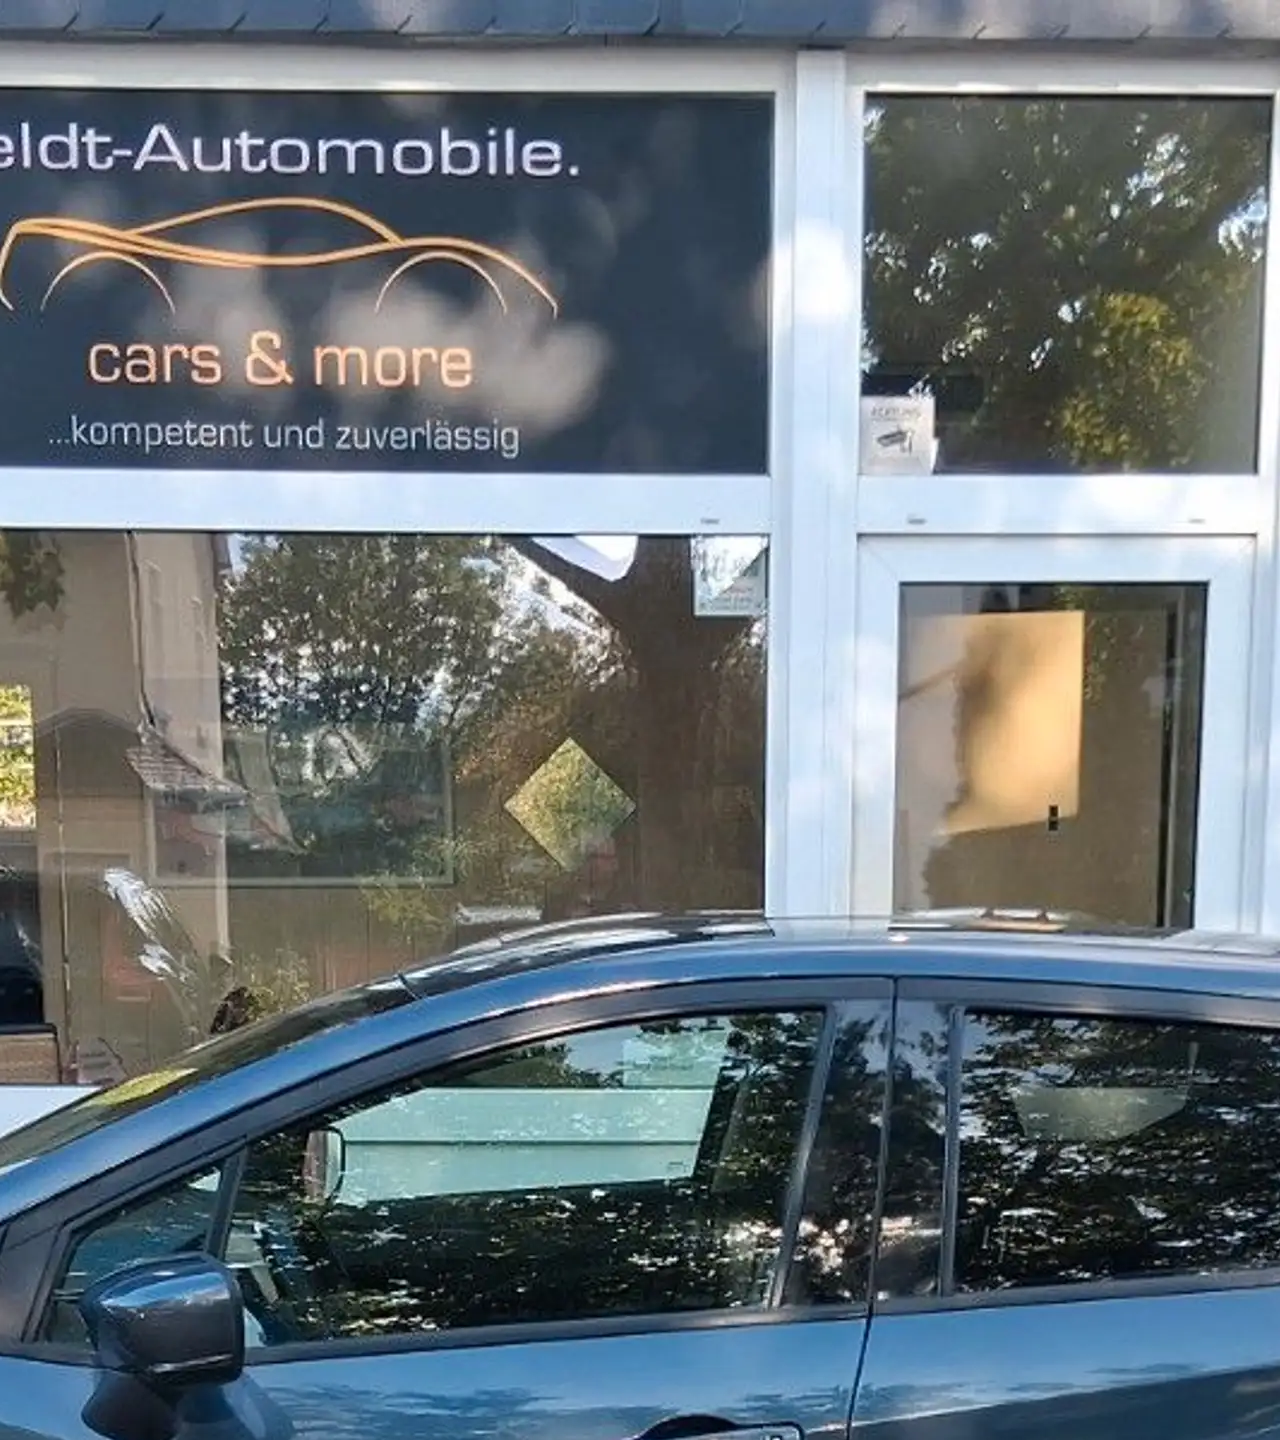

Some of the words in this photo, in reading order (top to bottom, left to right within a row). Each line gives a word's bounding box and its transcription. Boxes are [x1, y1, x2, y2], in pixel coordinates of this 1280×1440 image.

[88, 342, 223, 384] cars
[245, 330, 295, 386] &
[313, 346, 475, 388] more
[48, 415, 254, 455] ...kompetent
[263, 417, 324, 449] und
[335, 418, 520, 459] zuverlässig
